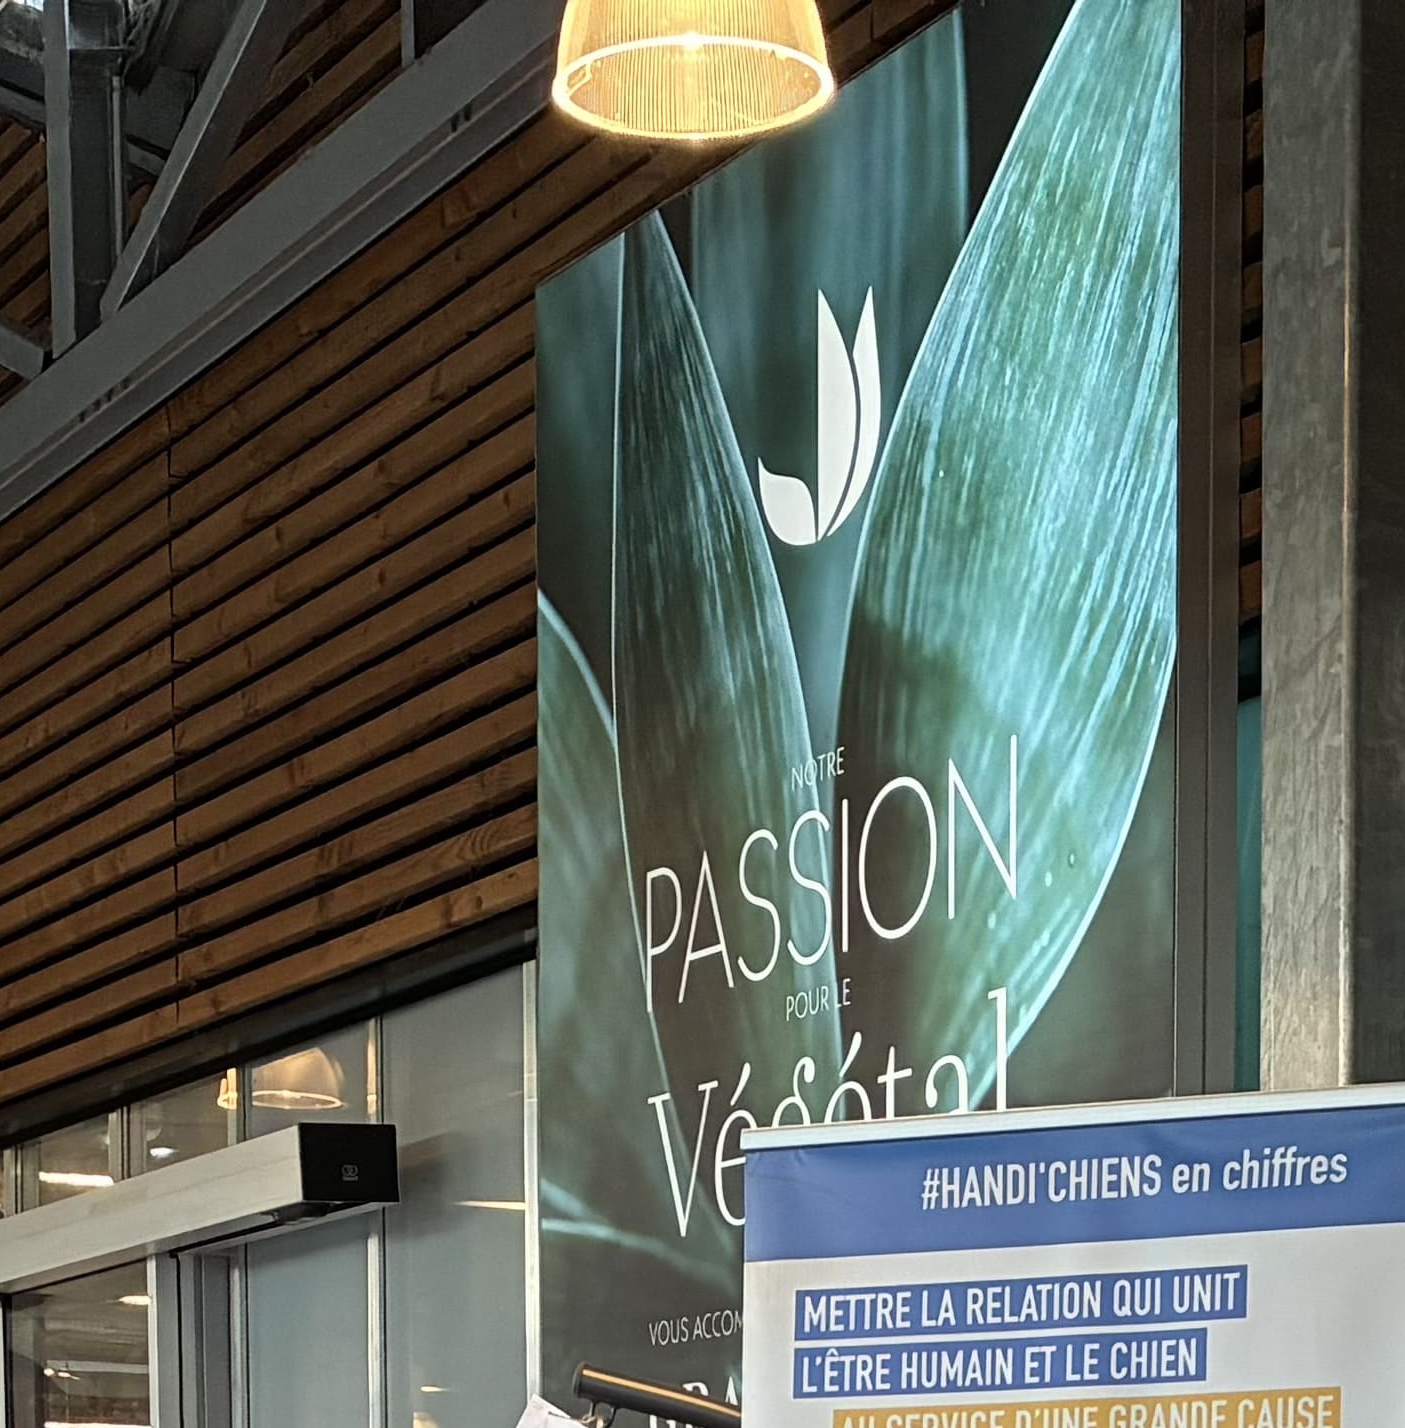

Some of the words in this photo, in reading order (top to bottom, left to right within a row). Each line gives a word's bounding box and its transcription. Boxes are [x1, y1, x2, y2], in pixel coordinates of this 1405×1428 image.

[790, 745, 846, 791] NOTRE
[645, 733, 1018, 1013] PASSION
[785, 984, 830, 1022] POUR
[834, 977, 853, 1010] LE
[921, 1154, 1162, 1212] #HANDI'CHIENS
[1172, 1163, 1211, 1193] en
[1222, 1145, 1349, 1191] chiffres
[648, 1315, 689, 1347] VOUS
[804, 1289, 911, 1334] METTRE
[919, 1286, 957, 1327] LA
[966, 1279, 1101, 1326] RELATION
[1112, 1277, 1162, 1321] QUI
[1173, 1271, 1241, 1314] UNIT
[801, 1345, 890, 1394] L'ÊTRE
[900, 1346, 1013, 1389] HUMAIN
[1024, 1344, 1056, 1383] ET
[1066, 1342, 1100, 1381] LE
[1110, 1337, 1198, 1380] CHIEN
